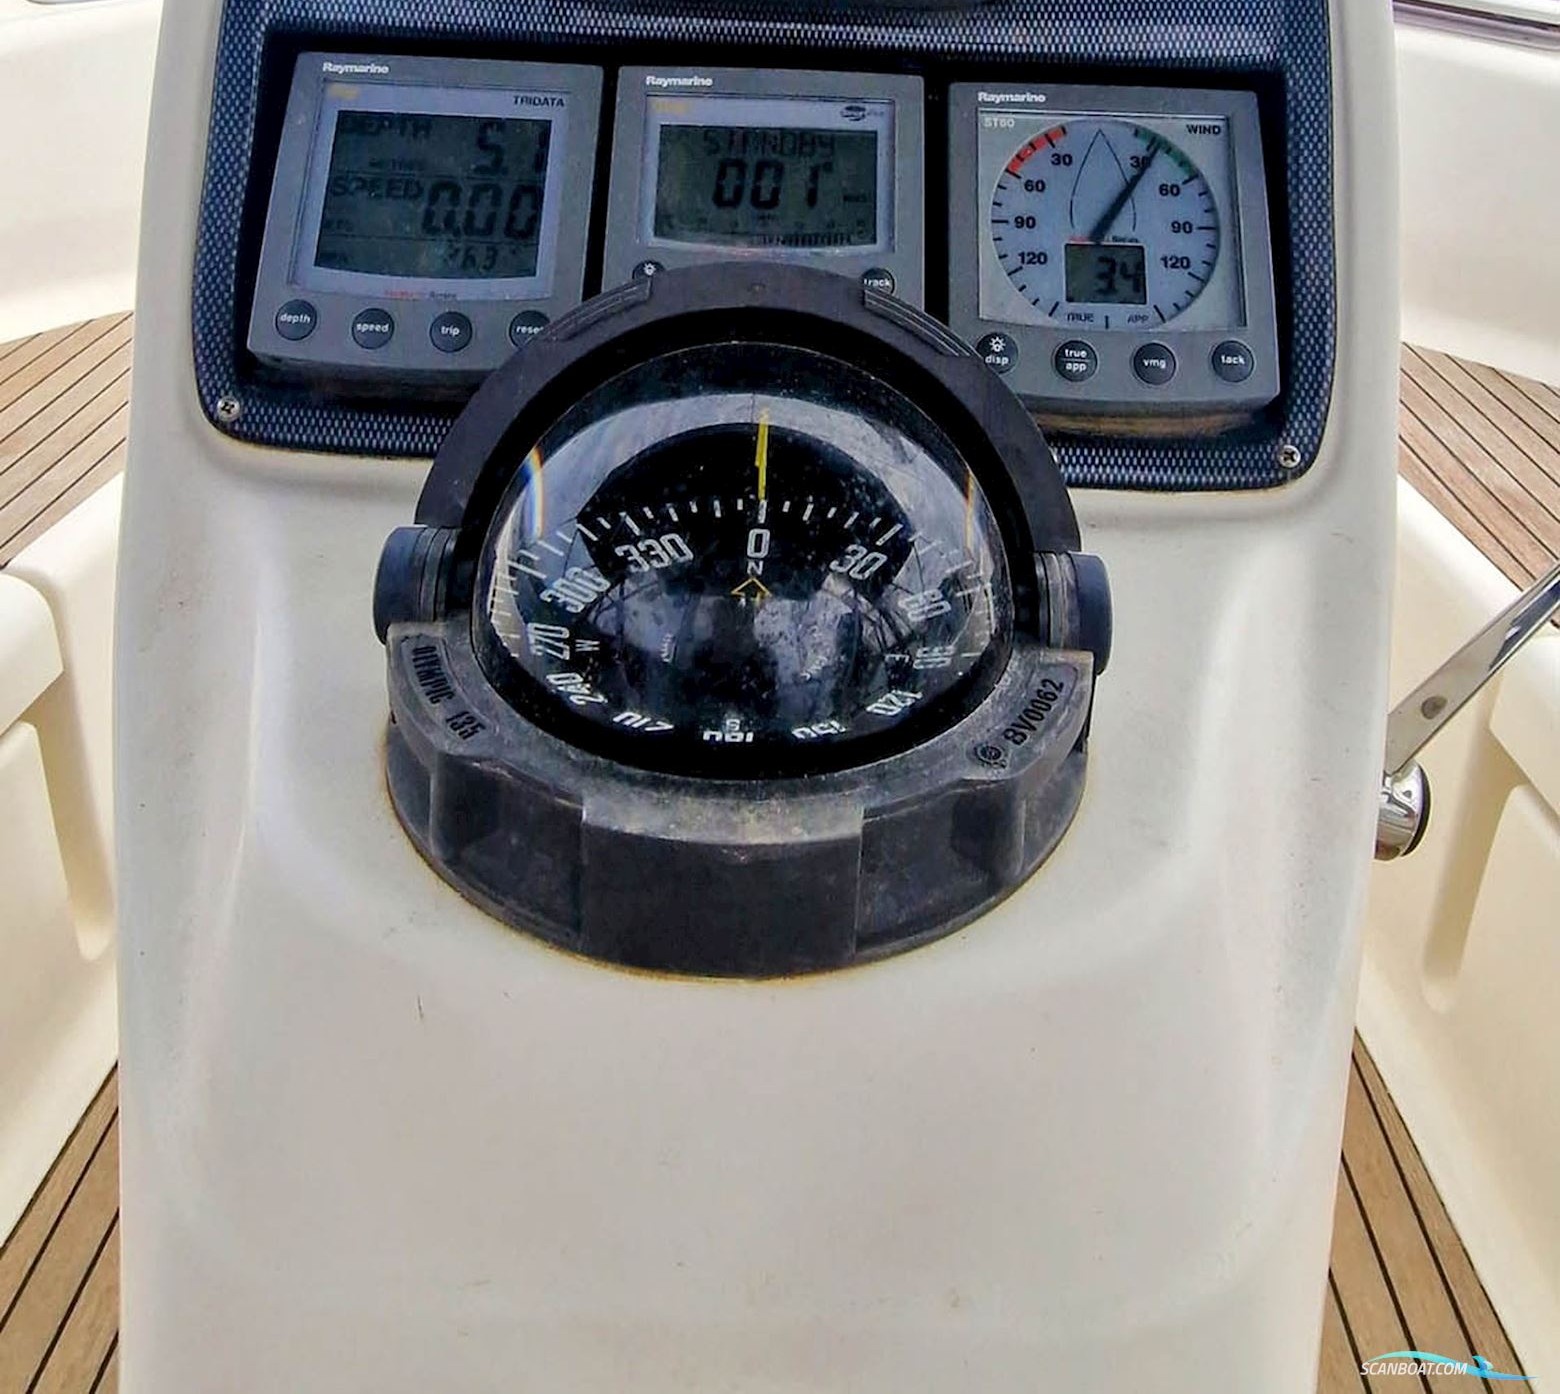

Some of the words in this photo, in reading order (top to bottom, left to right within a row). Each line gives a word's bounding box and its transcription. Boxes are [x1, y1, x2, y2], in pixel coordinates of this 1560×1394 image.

[322, 62, 389, 75] Raymarine
[646, 75, 713, 88] Raymarine
[512, 94, 565, 108] TRIDATA
[977, 92, 1046, 104] Raymarine
[984, 117, 1015, 128] ST60
[1186, 124, 1221, 136] WIND
[1050, 153, 1073, 167] 30
[330, 174, 424, 200] SPEED
[1024, 179, 1046, 193] 60
[1159, 183, 1181, 197] 60
[1014, 215, 1037, 229] 90
[1171, 220, 1193, 234] 90
[1018, 251, 1048, 265] 120
[1160, 256, 1191, 270] 120
[1095, 255, 1142, 295] 34
[280, 312, 311, 325] depth
[1067, 312, 1094, 323] TRUE
[1127, 314, 1149, 323] APP
[356, 322, 389, 333] speed
[441, 325, 460, 337] trip
[985, 354, 1009, 366] disp
[1065, 348, 1087, 358] true
[1220, 354, 1245, 365] tack
[1065, 362, 1087, 373] app
[1143, 358, 1166, 369] vmg
[747, 528, 770, 559] 0
[614, 533, 694, 574] 330
[747, 561, 763, 576] N
[829, 543, 888, 581] 30
[540, 566, 612, 613] 300
[526, 622, 570, 661] 270
[411, 645, 453, 705] OLYMPIC
[445, 709, 487, 741] 135
[546, 672, 609, 706] 240
